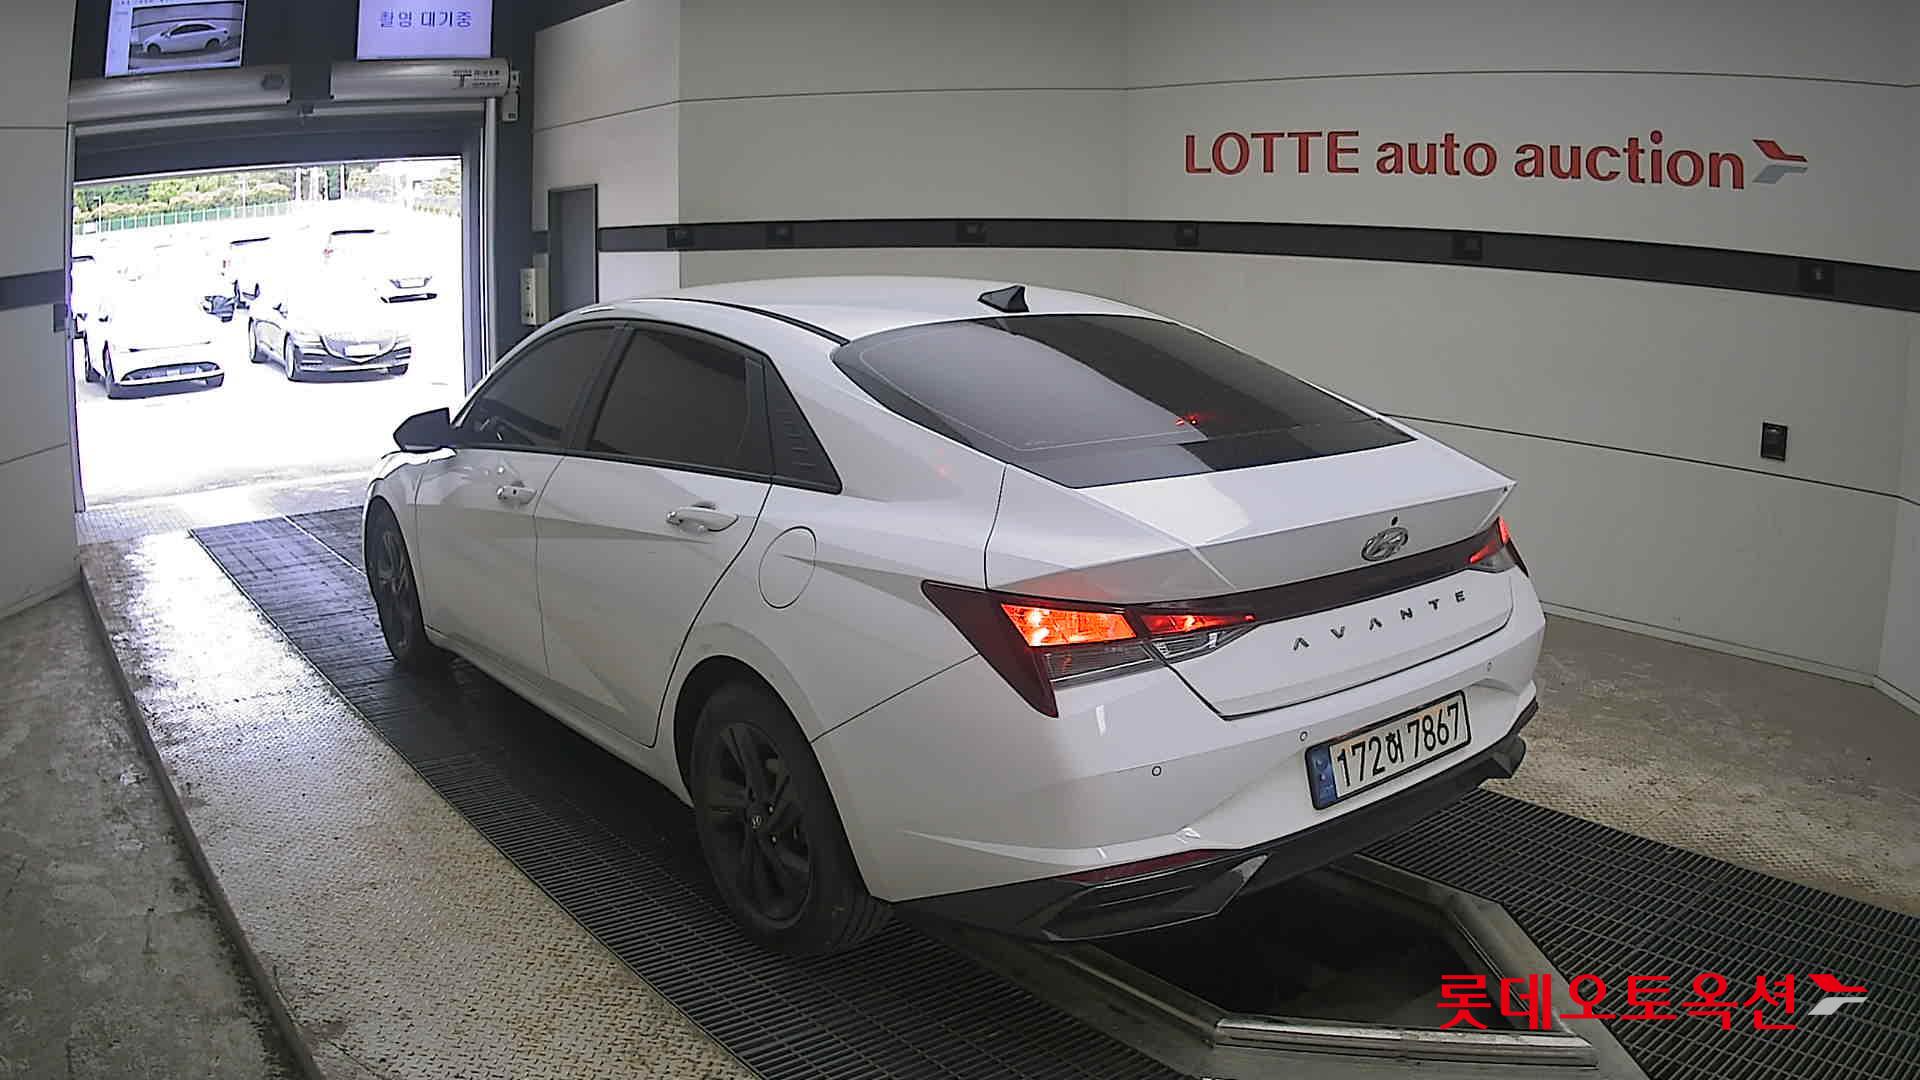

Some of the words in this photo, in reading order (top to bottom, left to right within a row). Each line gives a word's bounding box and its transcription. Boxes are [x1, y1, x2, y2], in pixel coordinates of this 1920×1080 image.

[421, 11, 471, 28] 대기중
[1185, 131, 1359, 174] LOTTE
[1376, 133, 1497, 177] auto
[1514, 131, 1744, 189] auction
[1293, 590, 1466, 651] AVANTE
[1337, 729, 1404, 787] 172허
[1407, 702, 1459, 759] 7867
